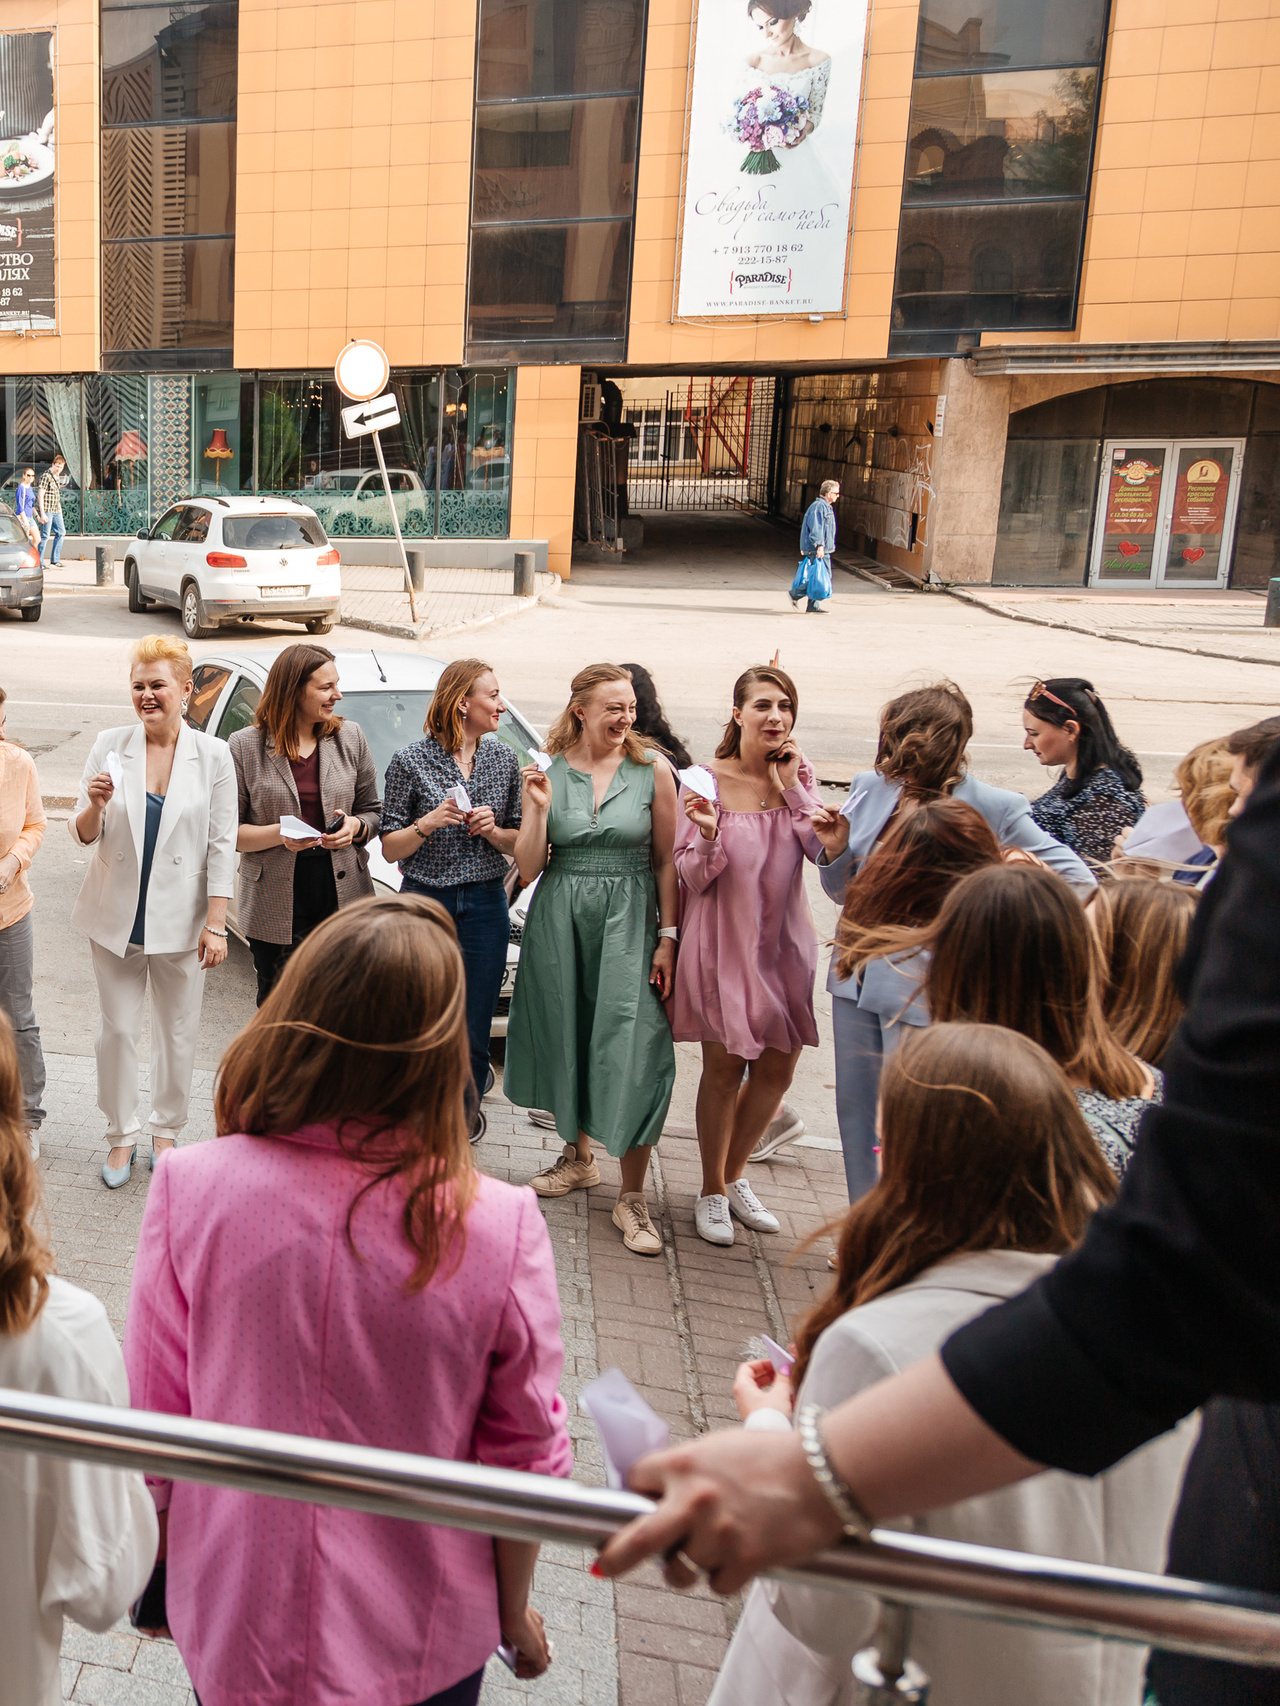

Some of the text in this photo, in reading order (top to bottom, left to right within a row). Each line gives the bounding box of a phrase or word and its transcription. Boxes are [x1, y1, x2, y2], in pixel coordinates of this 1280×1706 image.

[695, 184, 776, 225] Свадьба
[757, 209, 815, 222] самого
[731, 246, 751, 254] 913
[790, 243, 804, 252] 62
[738, 255, 788, 265] 222-15-87
[2, 288, 11, 296] 18
[12, 287, 23, 296] 62
